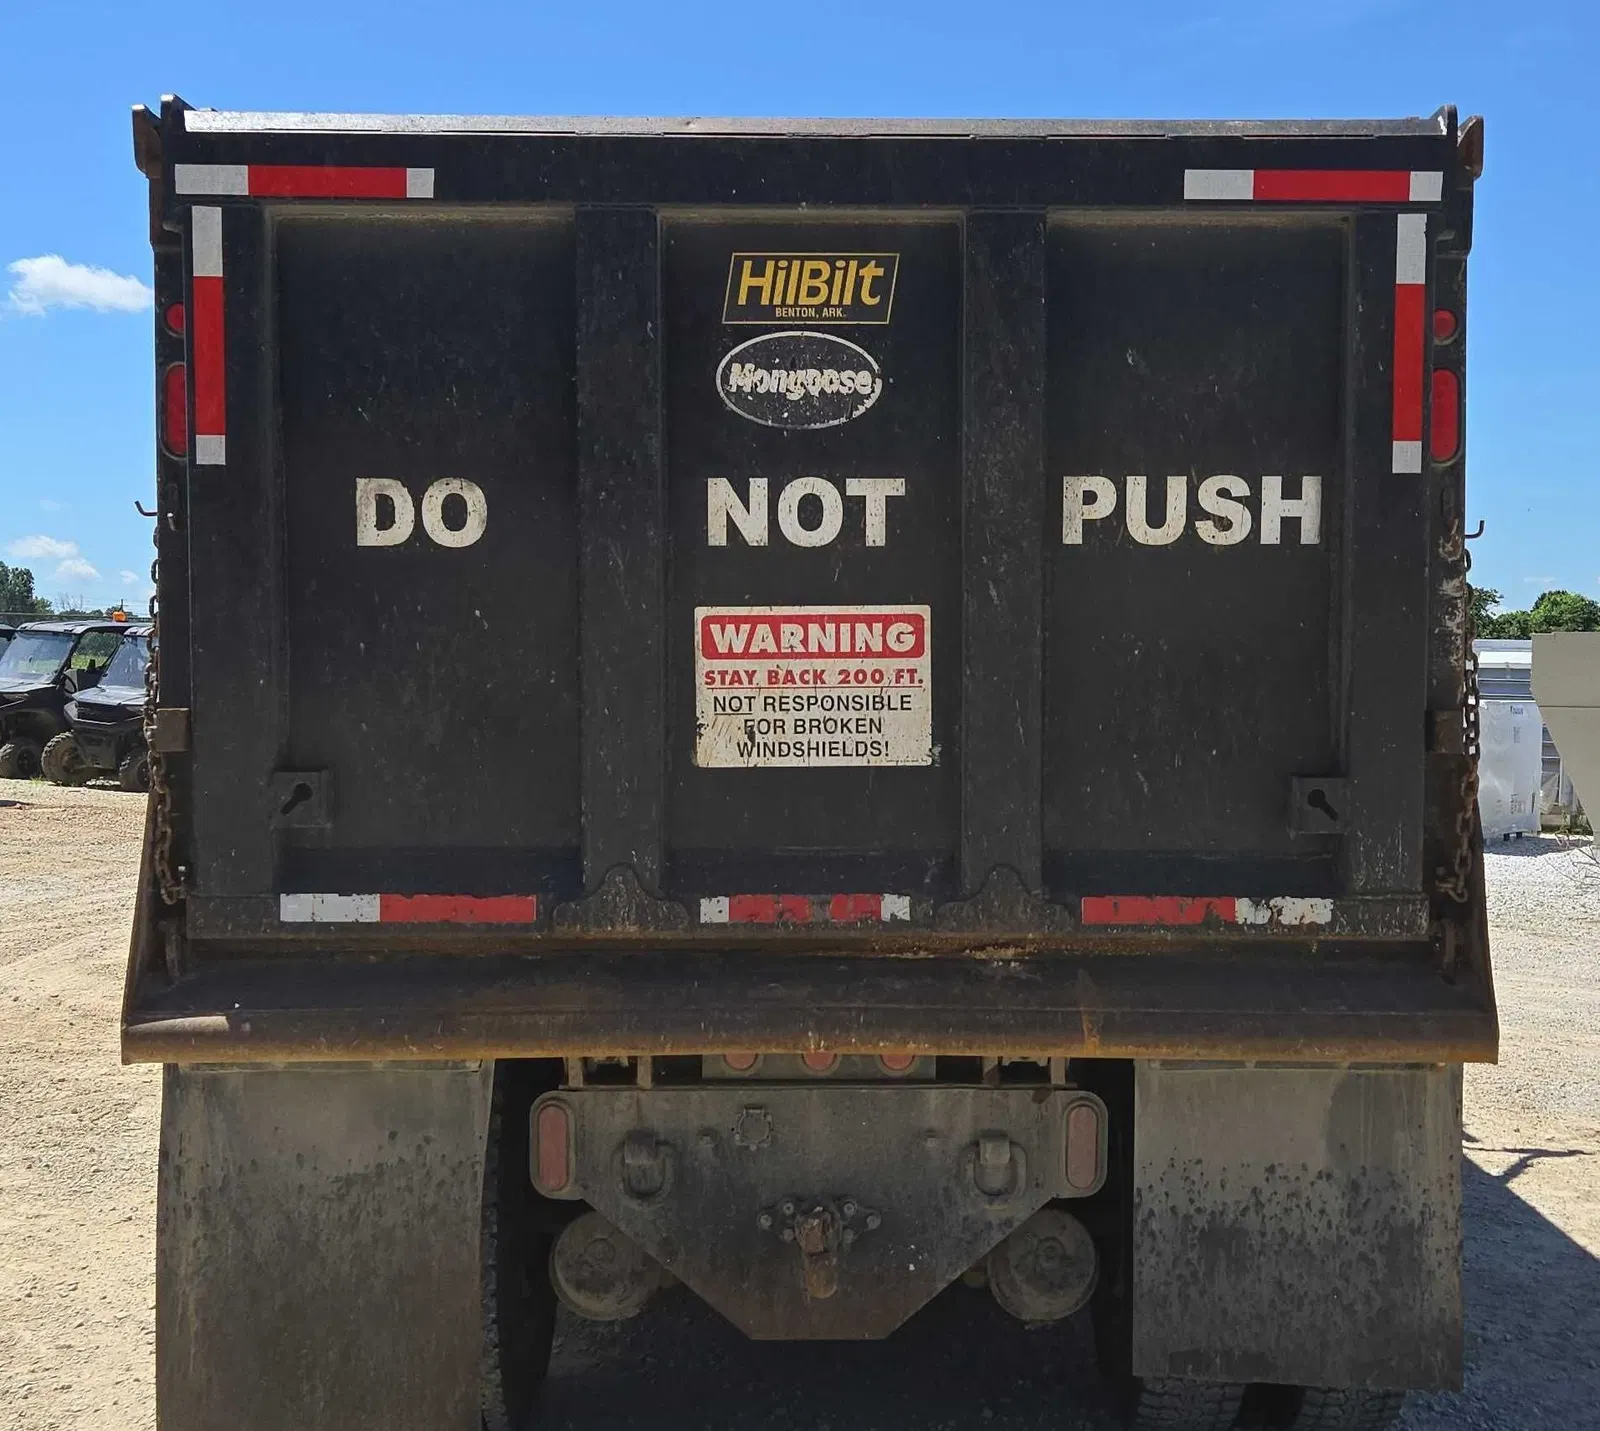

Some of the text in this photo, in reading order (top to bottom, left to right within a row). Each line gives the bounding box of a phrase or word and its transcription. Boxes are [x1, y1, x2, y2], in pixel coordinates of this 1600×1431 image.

[737, 260, 884, 306] HilBilt
[775, 307, 847, 318] BENTON, ARK.
[727, 362, 873, 401] Mongoose
[355, 475, 1322, 548] DO NOT PUSH
[710, 622, 916, 654] WARNING
[704, 668, 924, 686] STAY BACK 200 FT.
[714, 695, 912, 712] NOT RESPONSIBLE
[744, 717, 882, 735] FOR BROKEN
[737, 741, 890, 758] WINDSHIELDS!
